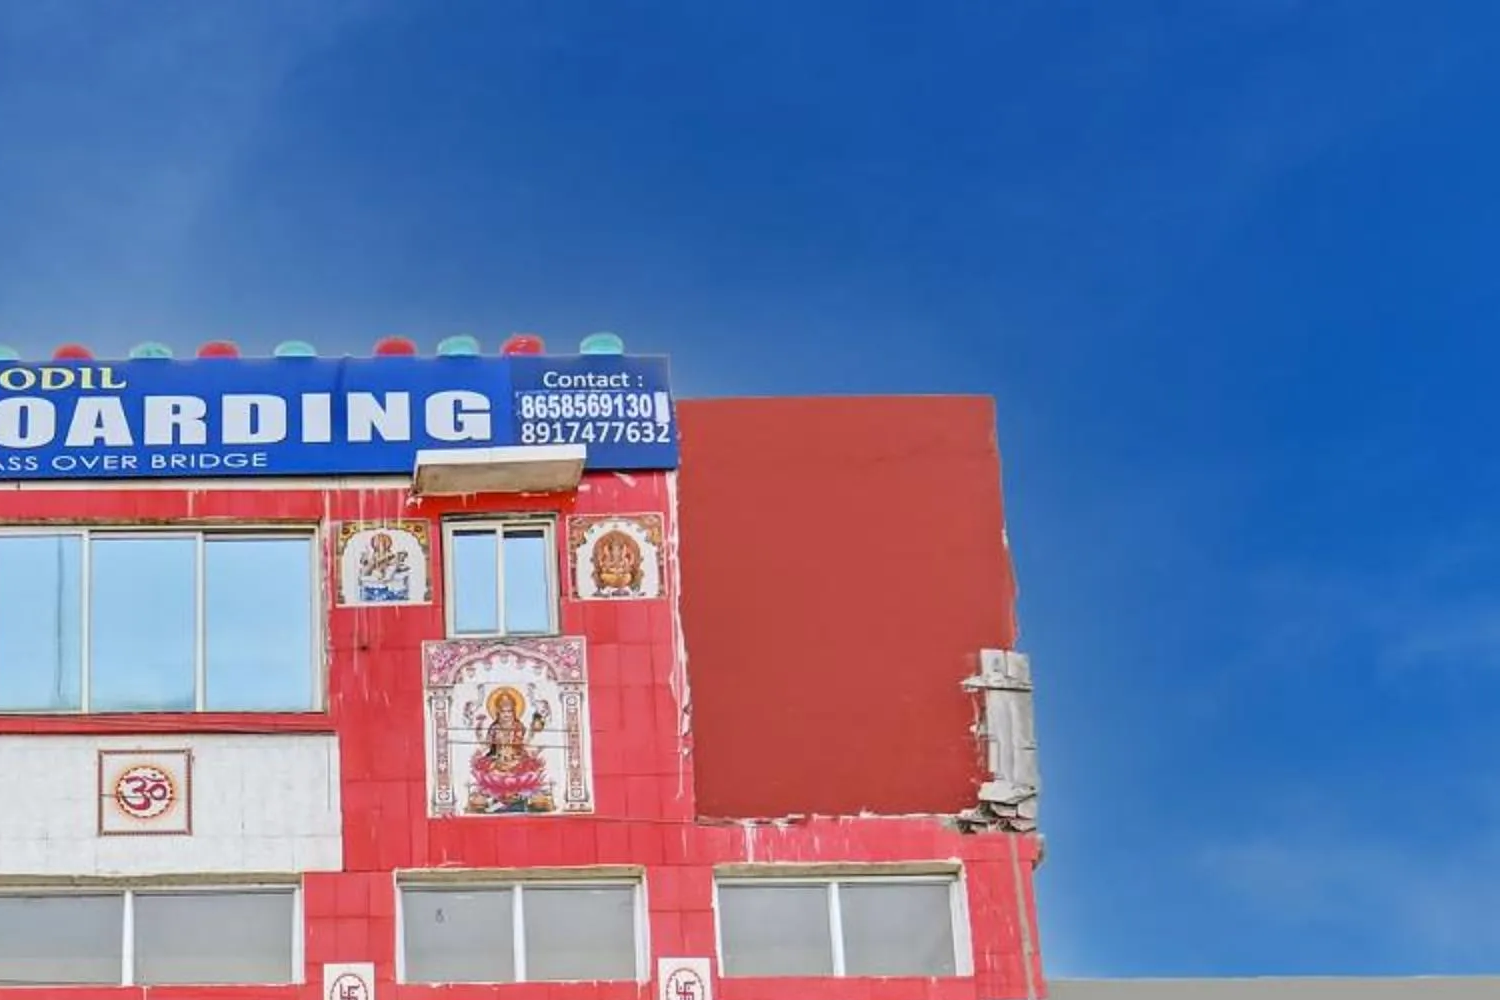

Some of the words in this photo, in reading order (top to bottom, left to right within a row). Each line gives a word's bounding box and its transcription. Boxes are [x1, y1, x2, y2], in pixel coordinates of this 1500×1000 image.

[543, 371, 630, 388] Contact
[521, 393, 652, 418] 8658569130
[521, 421, 671, 444] 8917477632
[52, 454, 138, 470] OVER
[151, 452, 268, 469] BRIDGE
